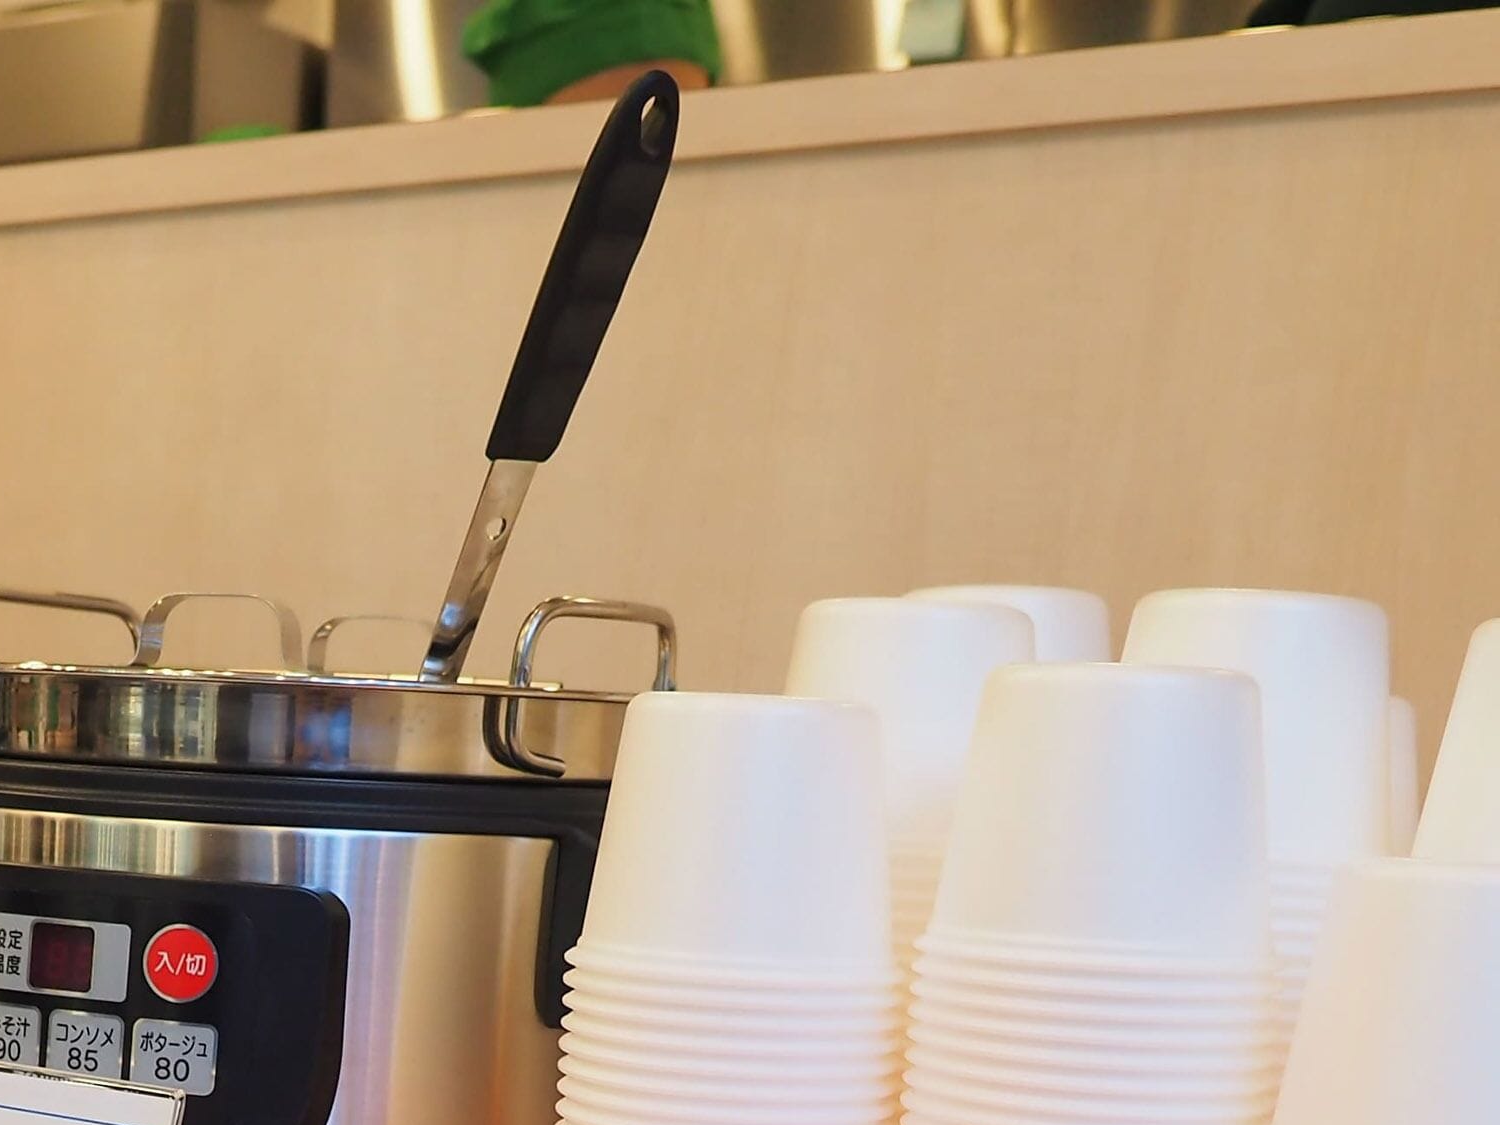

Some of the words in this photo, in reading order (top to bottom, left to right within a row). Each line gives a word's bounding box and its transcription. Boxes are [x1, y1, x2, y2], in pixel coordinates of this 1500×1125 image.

[154, 950, 206, 977] 入/切
[55, 1022, 115, 1047] コンソメ
[139, 1031, 209, 1058] ポタージュ
[67, 1049, 99, 1072] 85
[154, 1058, 190, 1083] 80
